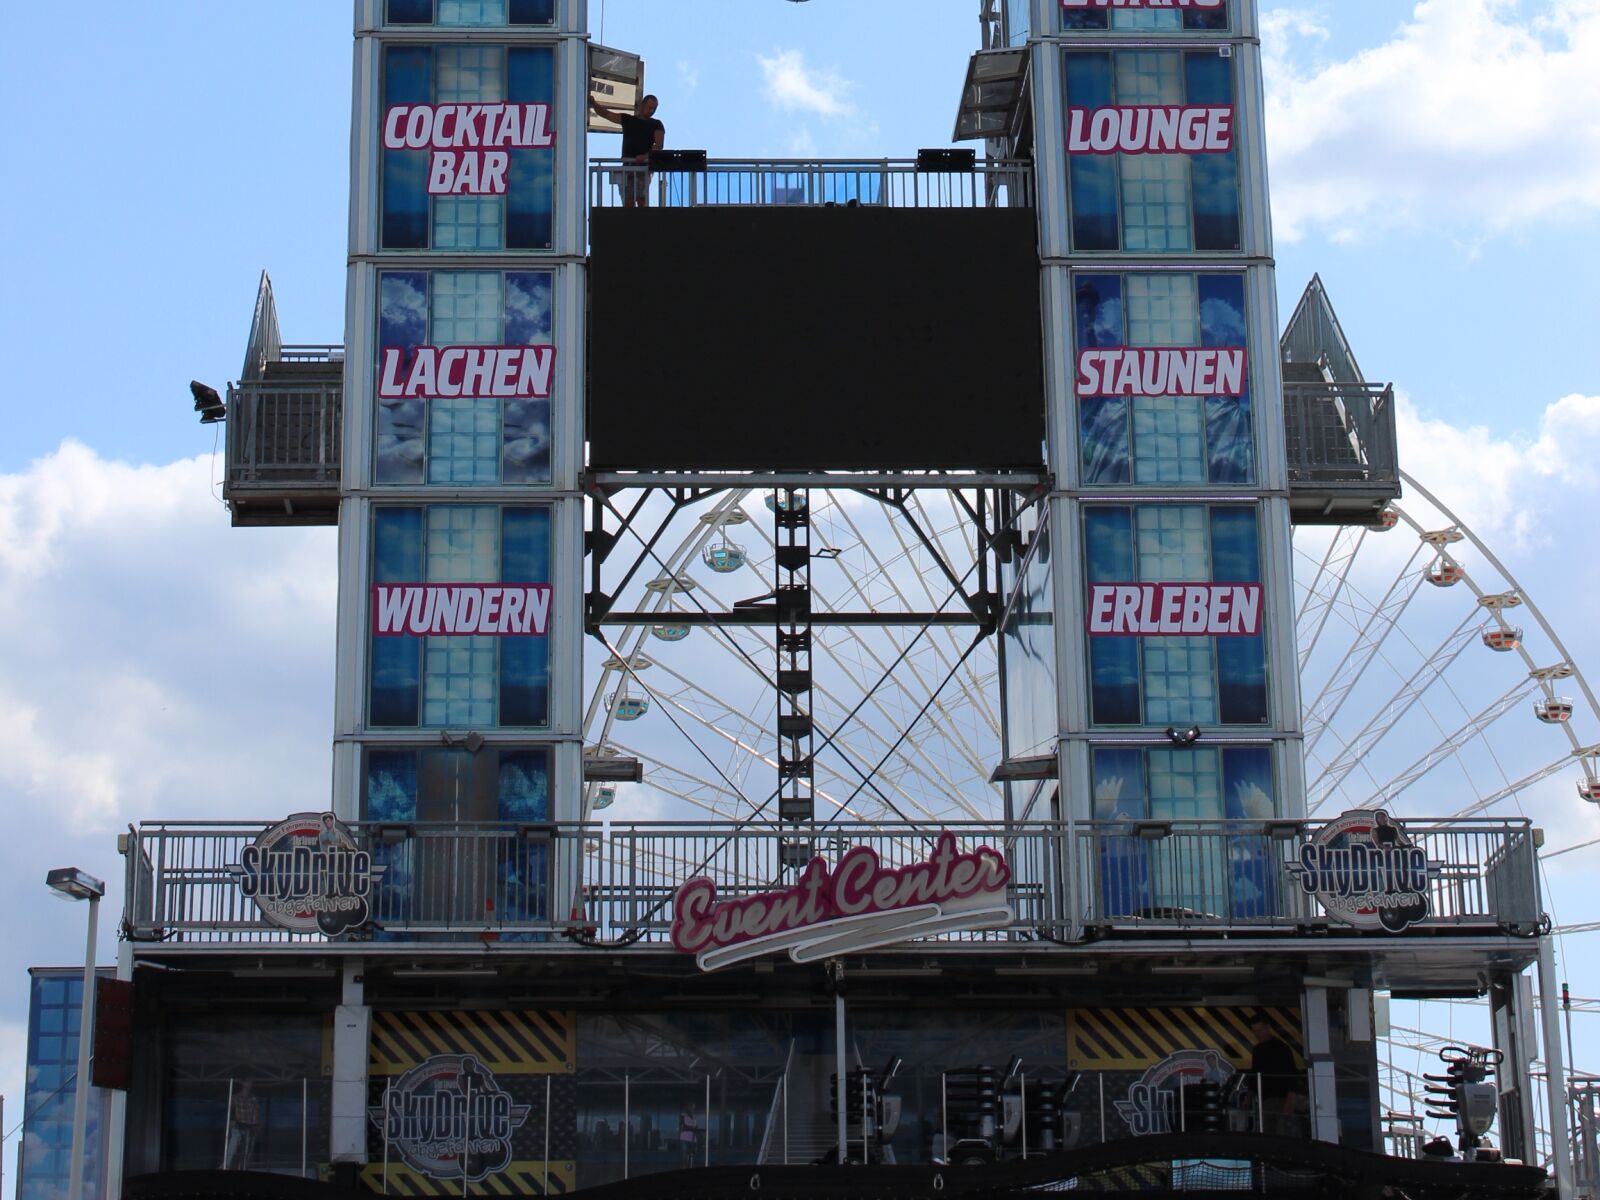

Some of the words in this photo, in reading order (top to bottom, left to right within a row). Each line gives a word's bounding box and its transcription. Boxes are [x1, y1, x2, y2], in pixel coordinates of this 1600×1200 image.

[383, 103, 553, 148] COCKTAIL
[1067, 107, 1232, 152] LOUNGE
[427, 151, 508, 194] BAR
[379, 347, 553, 397] LACHEN
[1076, 349, 1244, 396] STAUNEN
[376, 585, 551, 634] WUNDERN
[1089, 584, 1260, 635] ERLEBEN
[240, 846, 370, 900] SkyDrive
[674, 863, 827, 949] Event
[833, 834, 1008, 915] Center
[1300, 843, 1428, 896] SkyDrive
[265, 896, 361, 916] abgefahren
[1328, 892, 1421, 912] abgefahren
[384, 1090, 511, 1142] SkyDrive
